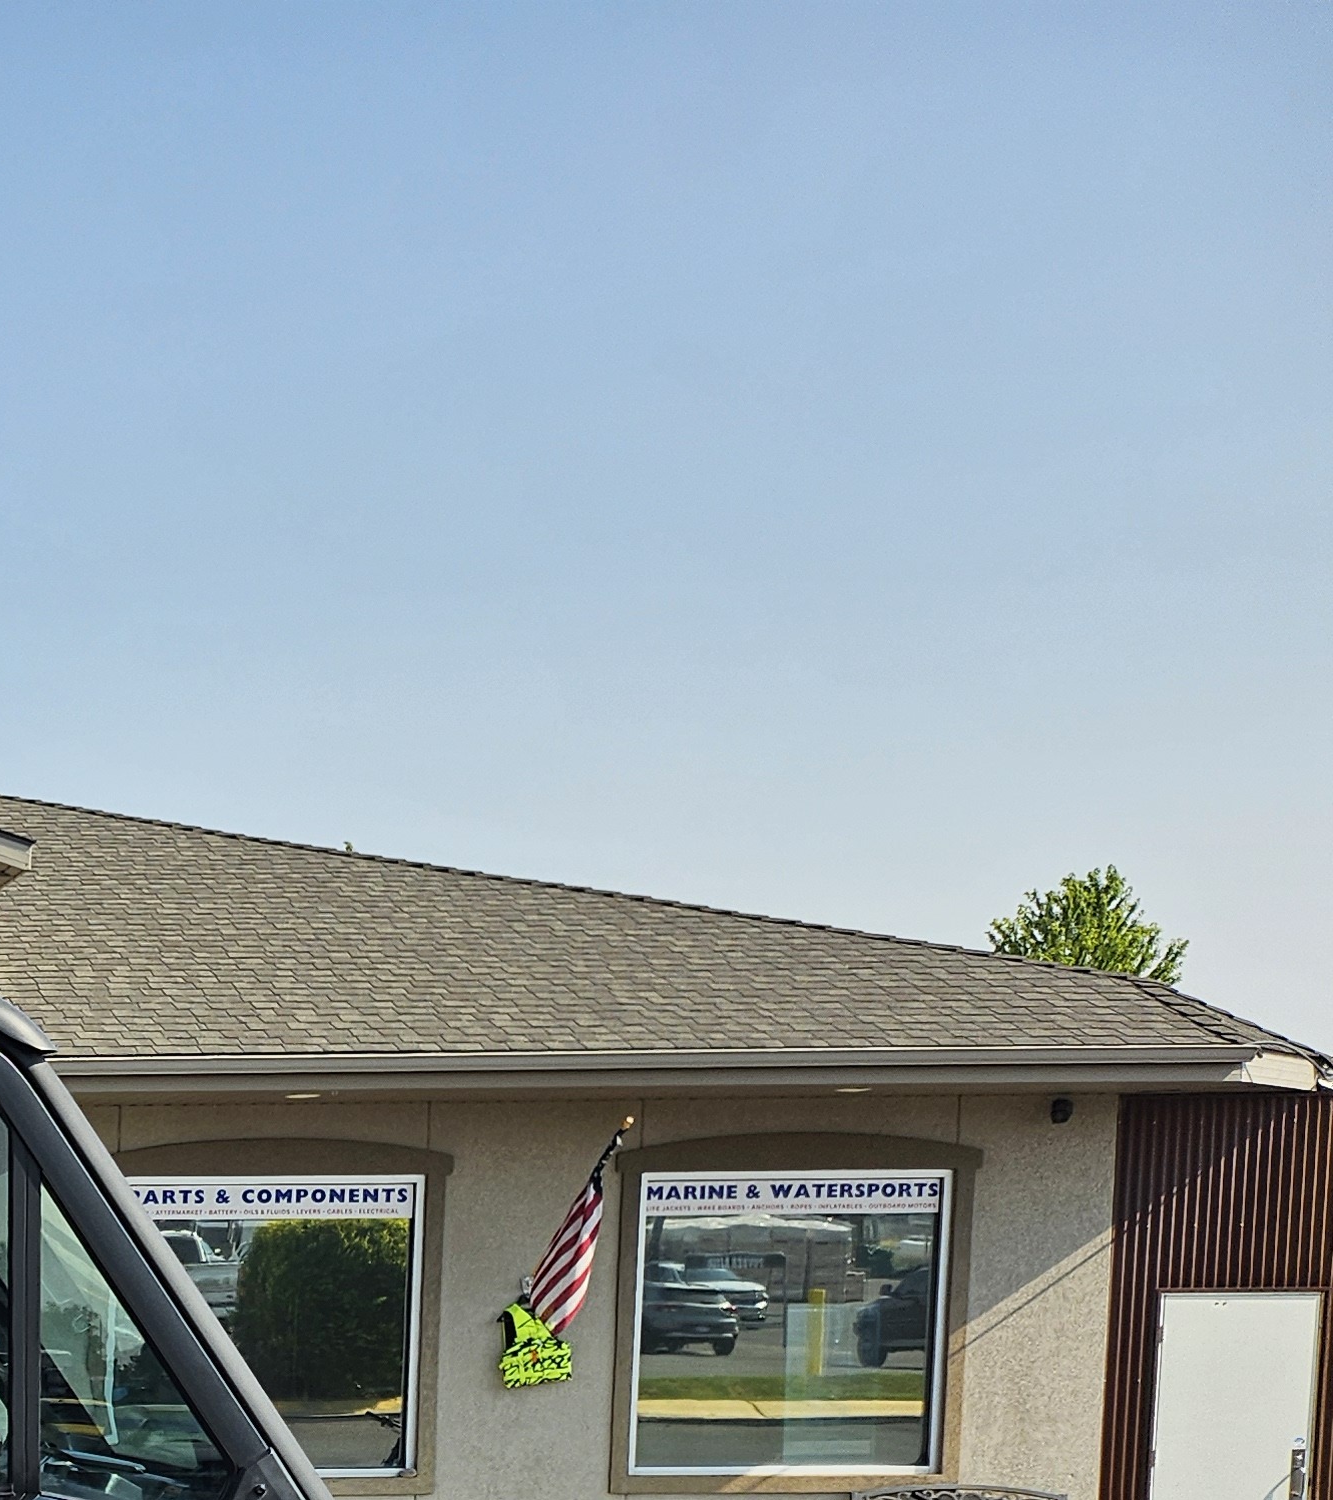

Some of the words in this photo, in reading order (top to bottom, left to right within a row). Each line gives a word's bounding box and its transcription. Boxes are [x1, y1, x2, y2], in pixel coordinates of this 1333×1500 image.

[215, 1189, 230, 1204] &
[241, 1187, 408, 1204] COMPONENTS
[647, 1185, 737, 1200] MARINE
[746, 1184, 761, 1199] &
[770, 1182, 938, 1199] WATERSPORTS
